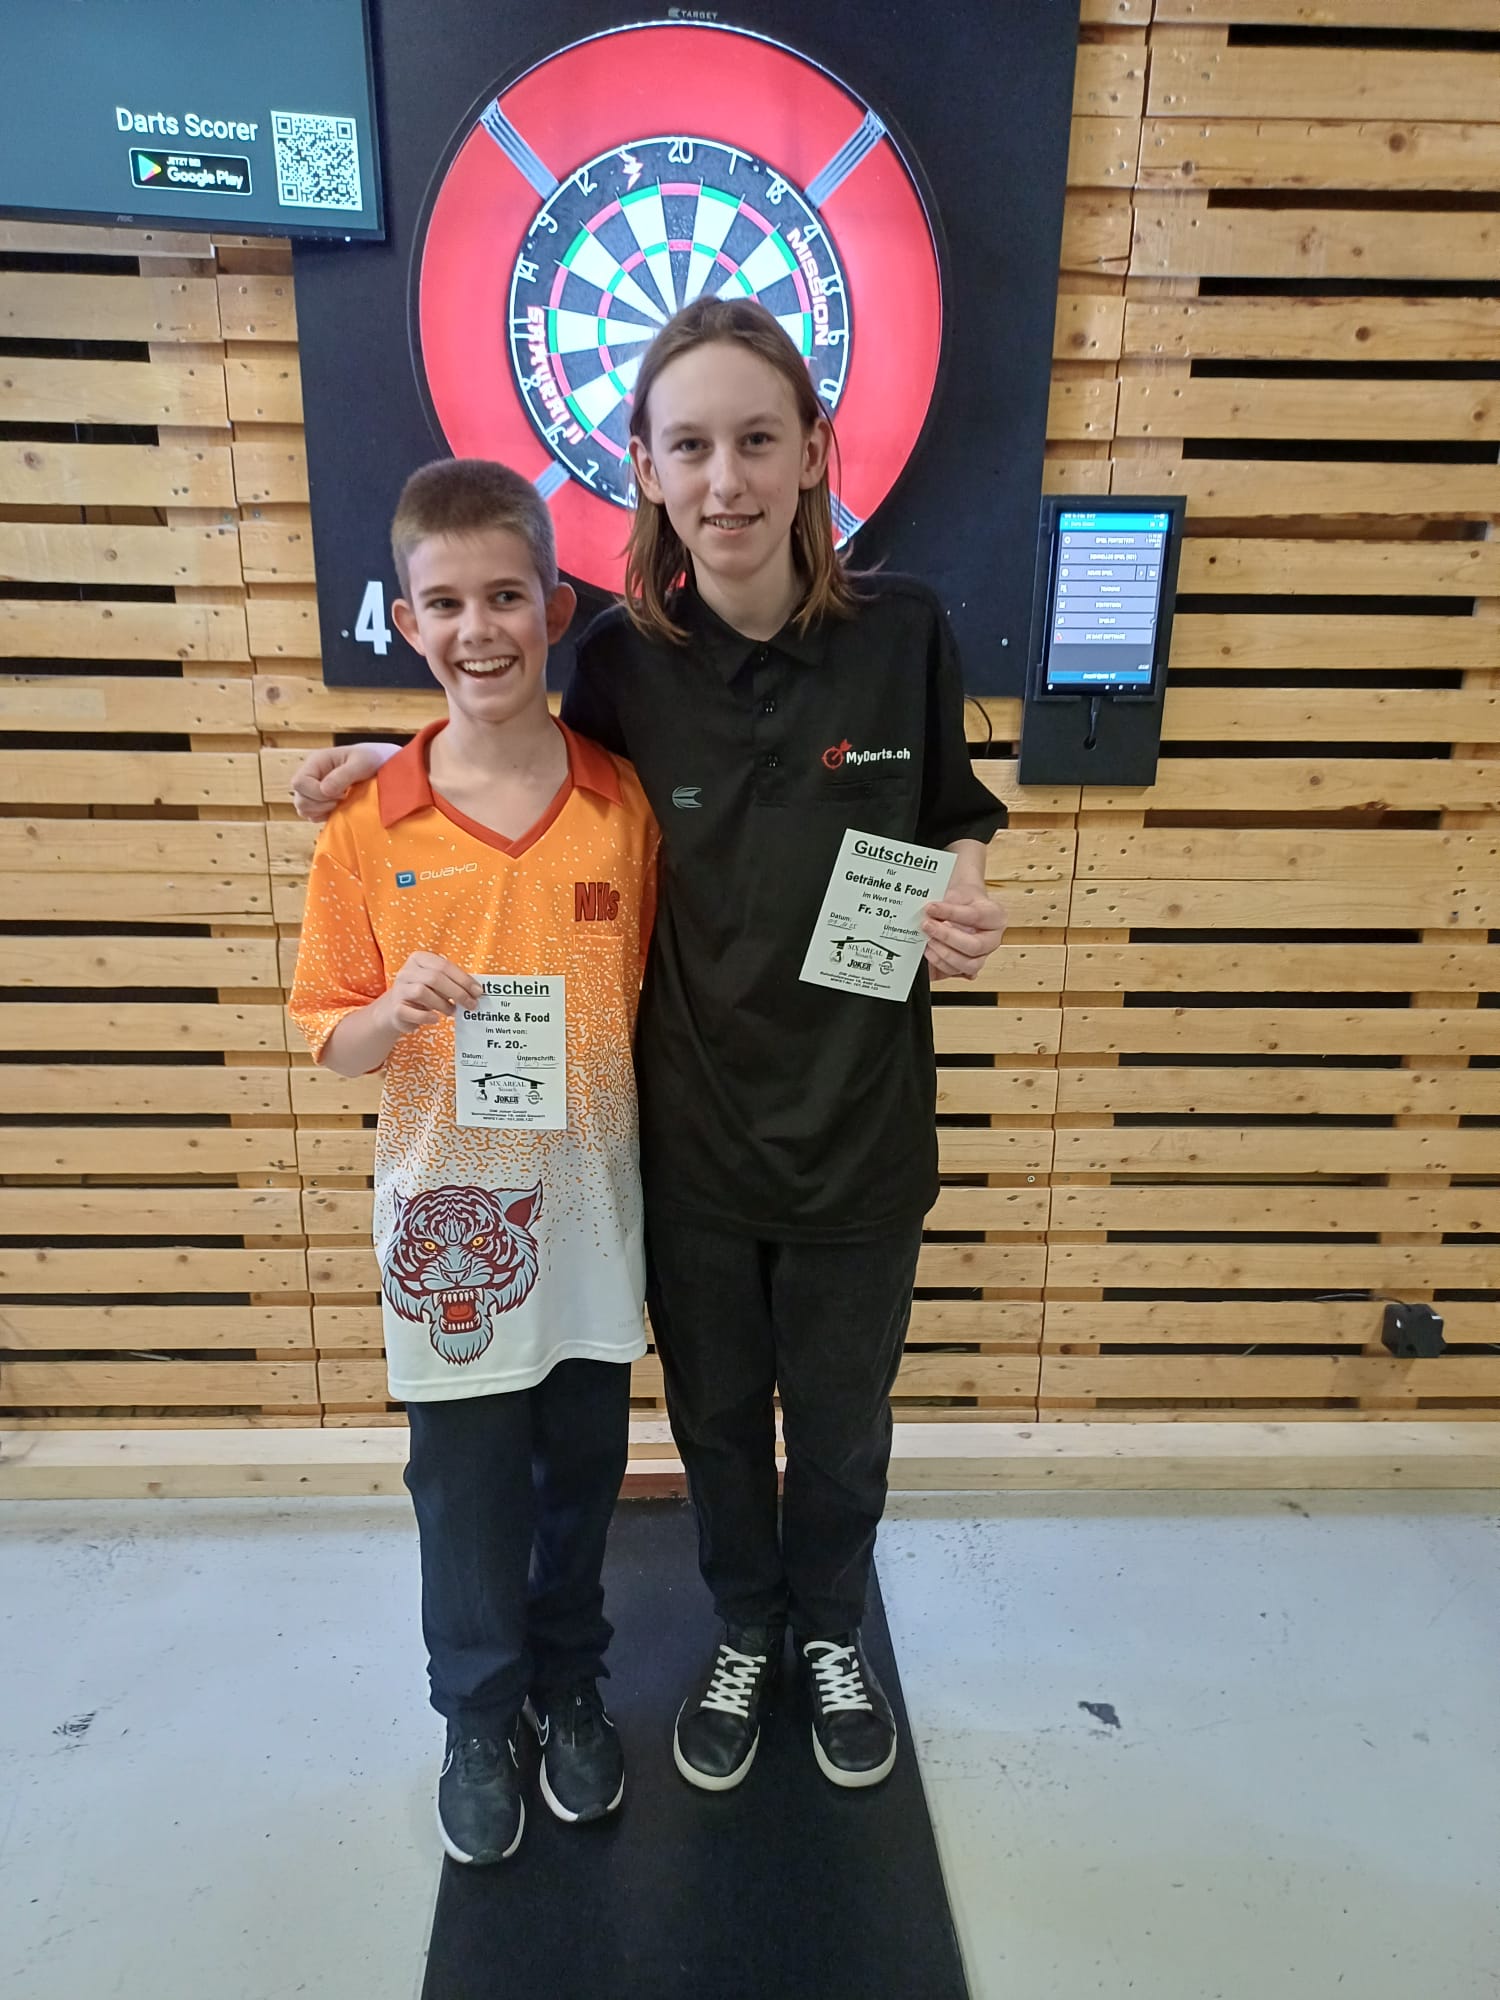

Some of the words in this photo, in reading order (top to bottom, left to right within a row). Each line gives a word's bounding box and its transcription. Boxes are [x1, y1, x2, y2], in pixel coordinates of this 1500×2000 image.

[681, 10, 718, 20] TARGET
[115, 106, 180, 136] Darts
[184, 113, 259, 141] Scorer
[668, 137, 694, 164] 20
[167, 166, 215, 187] Google
[216, 169, 244, 190] Play
[786, 228, 830, 346] MISSION
[355, 581, 392, 655] 4
[846, 747, 911, 766] MyDarts.ch
[854, 840, 939, 871] Gutschein
[886, 868, 897, 876] für
[845, 870, 892, 890] Getränke
[894, 882, 902, 892] &
[904, 884, 930, 898] Food
[574, 881, 621, 922] Nils
[872, 893, 888, 903] Wert
[857, 903, 872, 915] Fr.
[875, 907, 897, 919] 30.-
[482, 980, 550, 995] tschein
[500, 1000, 511, 1008] für
[463, 1010, 511, 1022] Getränke
[513, 1012, 522, 1023] &
[525, 1012, 550, 1023] Food
[487, 1039, 502, 1049] Fr.
[504, 1040, 528, 1049] 20.-
